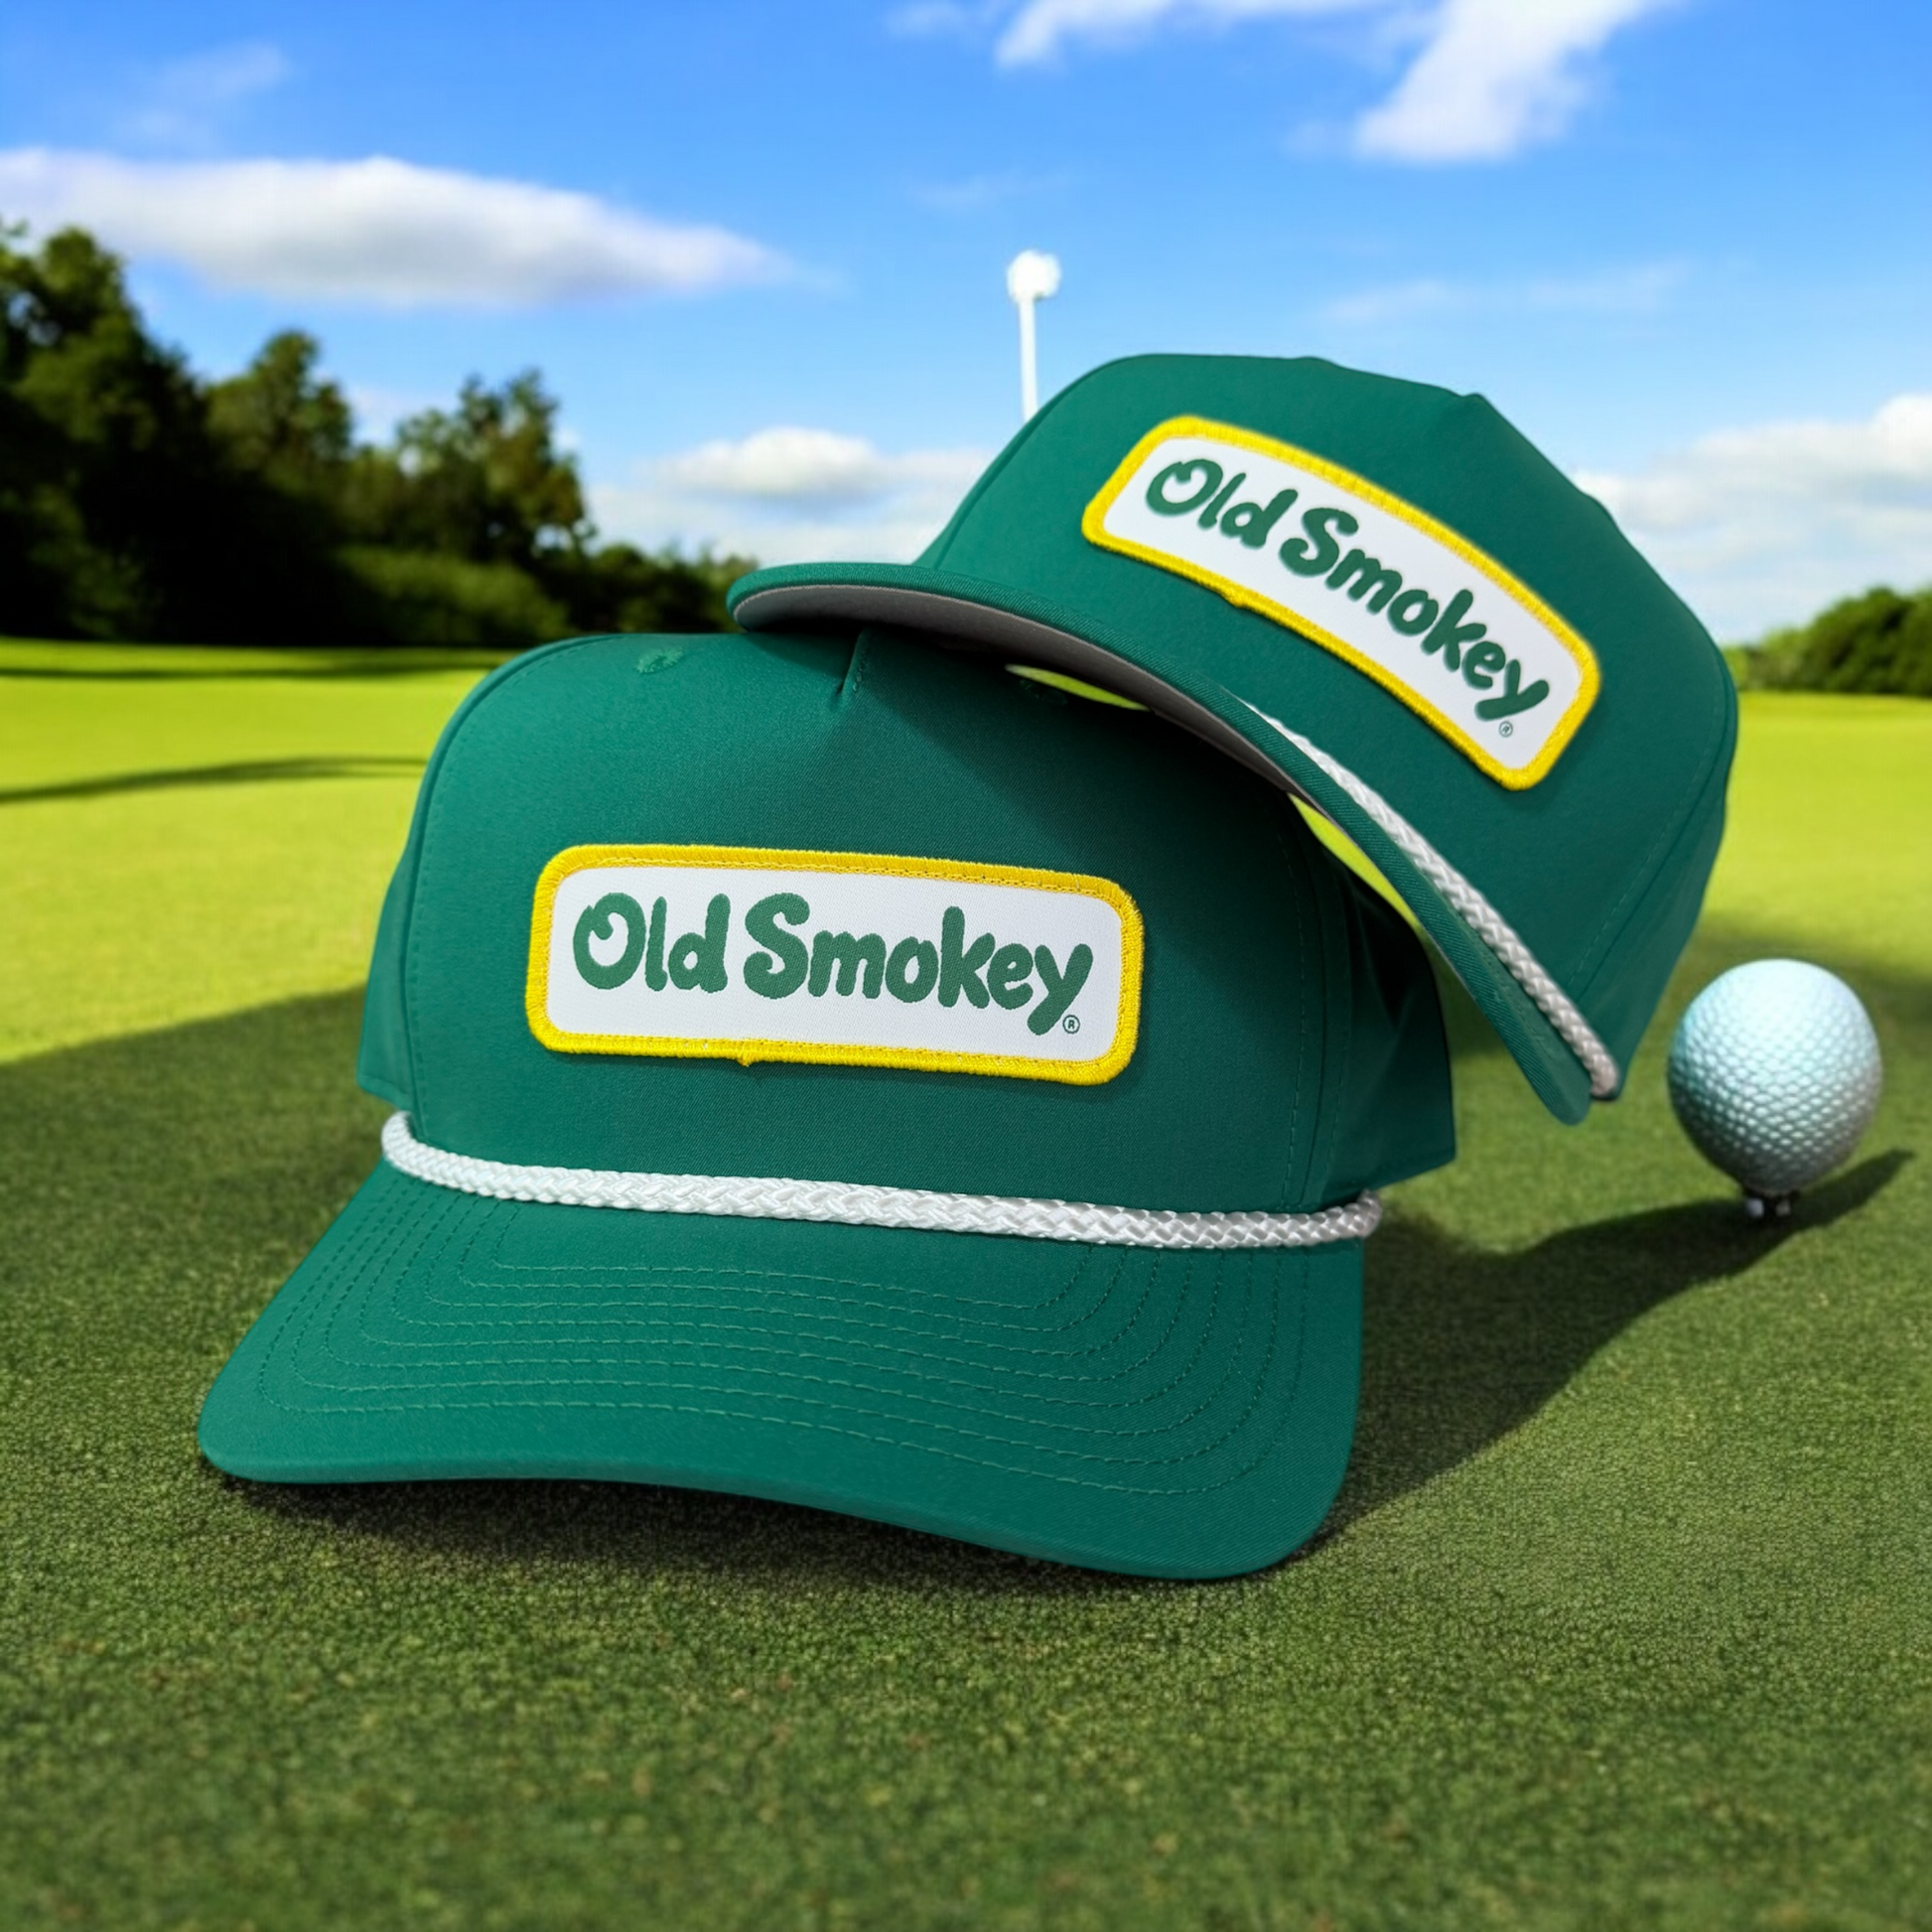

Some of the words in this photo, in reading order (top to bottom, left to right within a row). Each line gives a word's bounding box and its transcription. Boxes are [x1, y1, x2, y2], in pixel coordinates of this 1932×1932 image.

[1146, 459, 1298, 548] Old
[1279, 507, 1549, 722] Smokey
[573, 893, 730, 993] Old
[744, 893, 1093, 1035] Smokey
